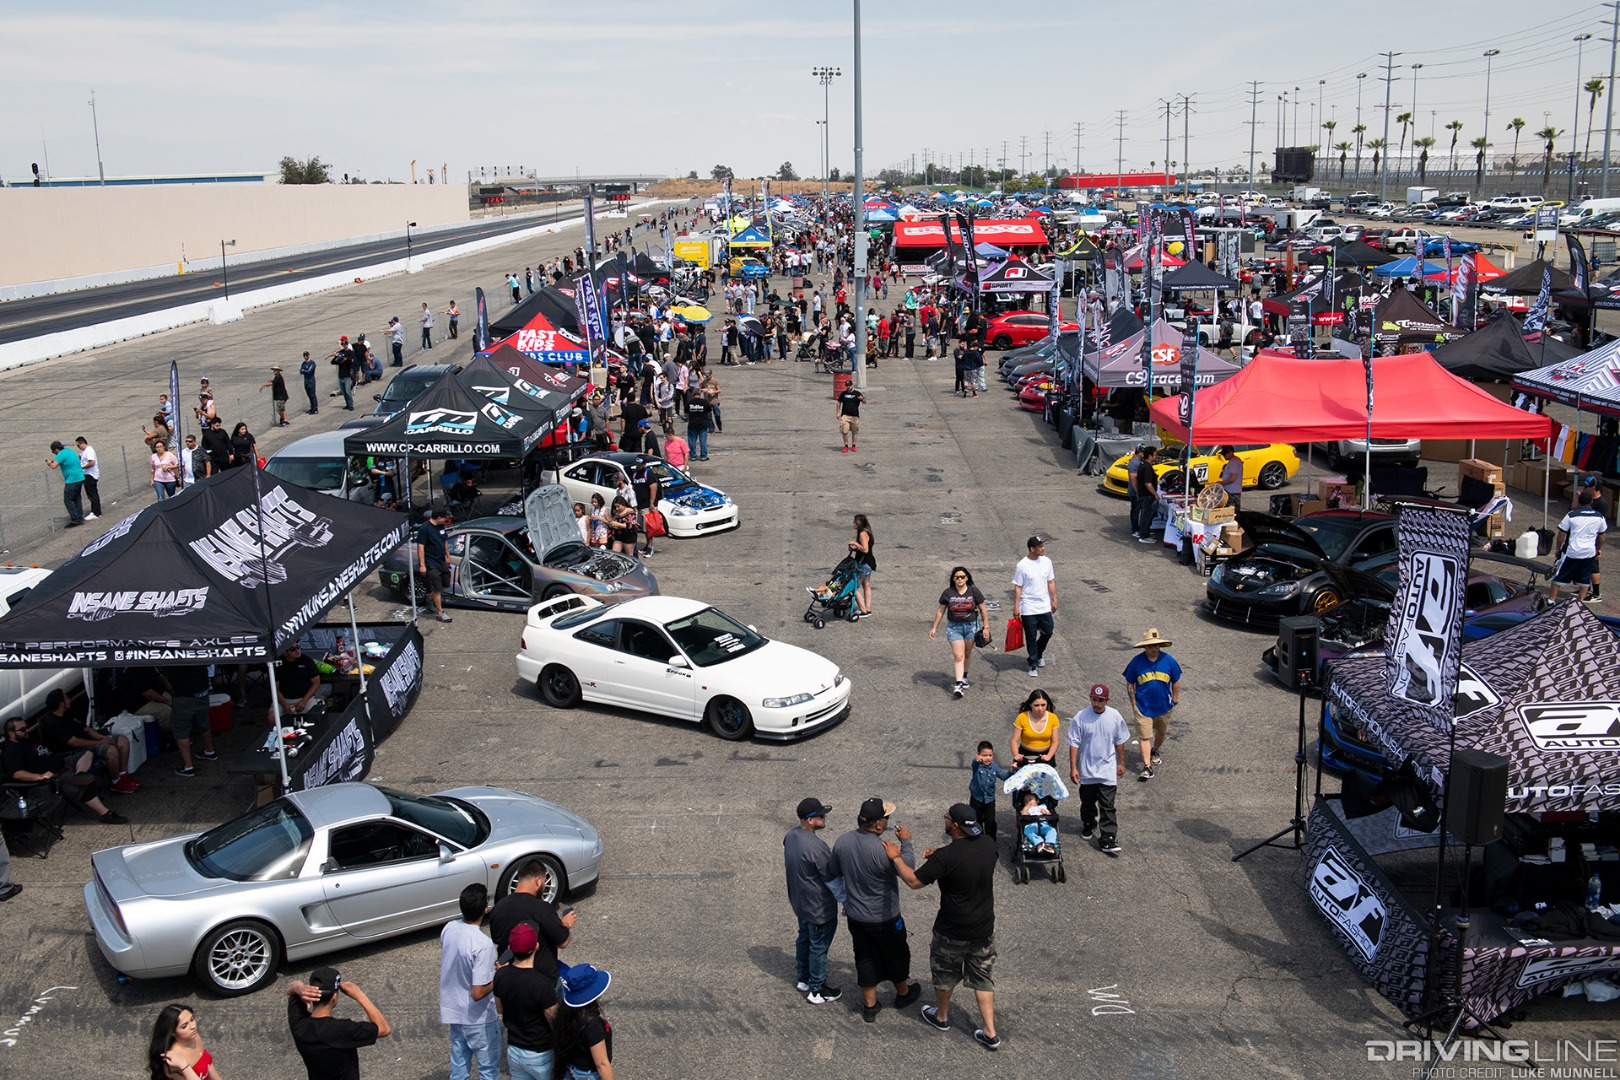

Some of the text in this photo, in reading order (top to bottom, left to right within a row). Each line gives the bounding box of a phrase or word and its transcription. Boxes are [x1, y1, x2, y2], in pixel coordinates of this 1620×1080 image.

[584, 279, 598, 310] FAST
[519, 329, 557, 340] FAST
[517, 338, 555, 350] KIDS
[548, 352, 583, 361] CLUB
[1152, 349, 1177, 362] CSF
[404, 426, 473, 435] CARRILLO
[366, 443, 501, 453] WWW.CP-CARRILLO.COM
[189, 485, 317, 582] INSANE SHAFTS
[68, 587, 209, 613] INSANE SHAFTS
[1393, 557, 1426, 696] AUTOFASHION
[25, 640, 181, 655] PERFORMANCE
[190, 635, 259, 648] AXLES
[126, 647, 267, 661] #INSANESHAFTS
[1311, 884, 1376, 957] AUTOFASHION
